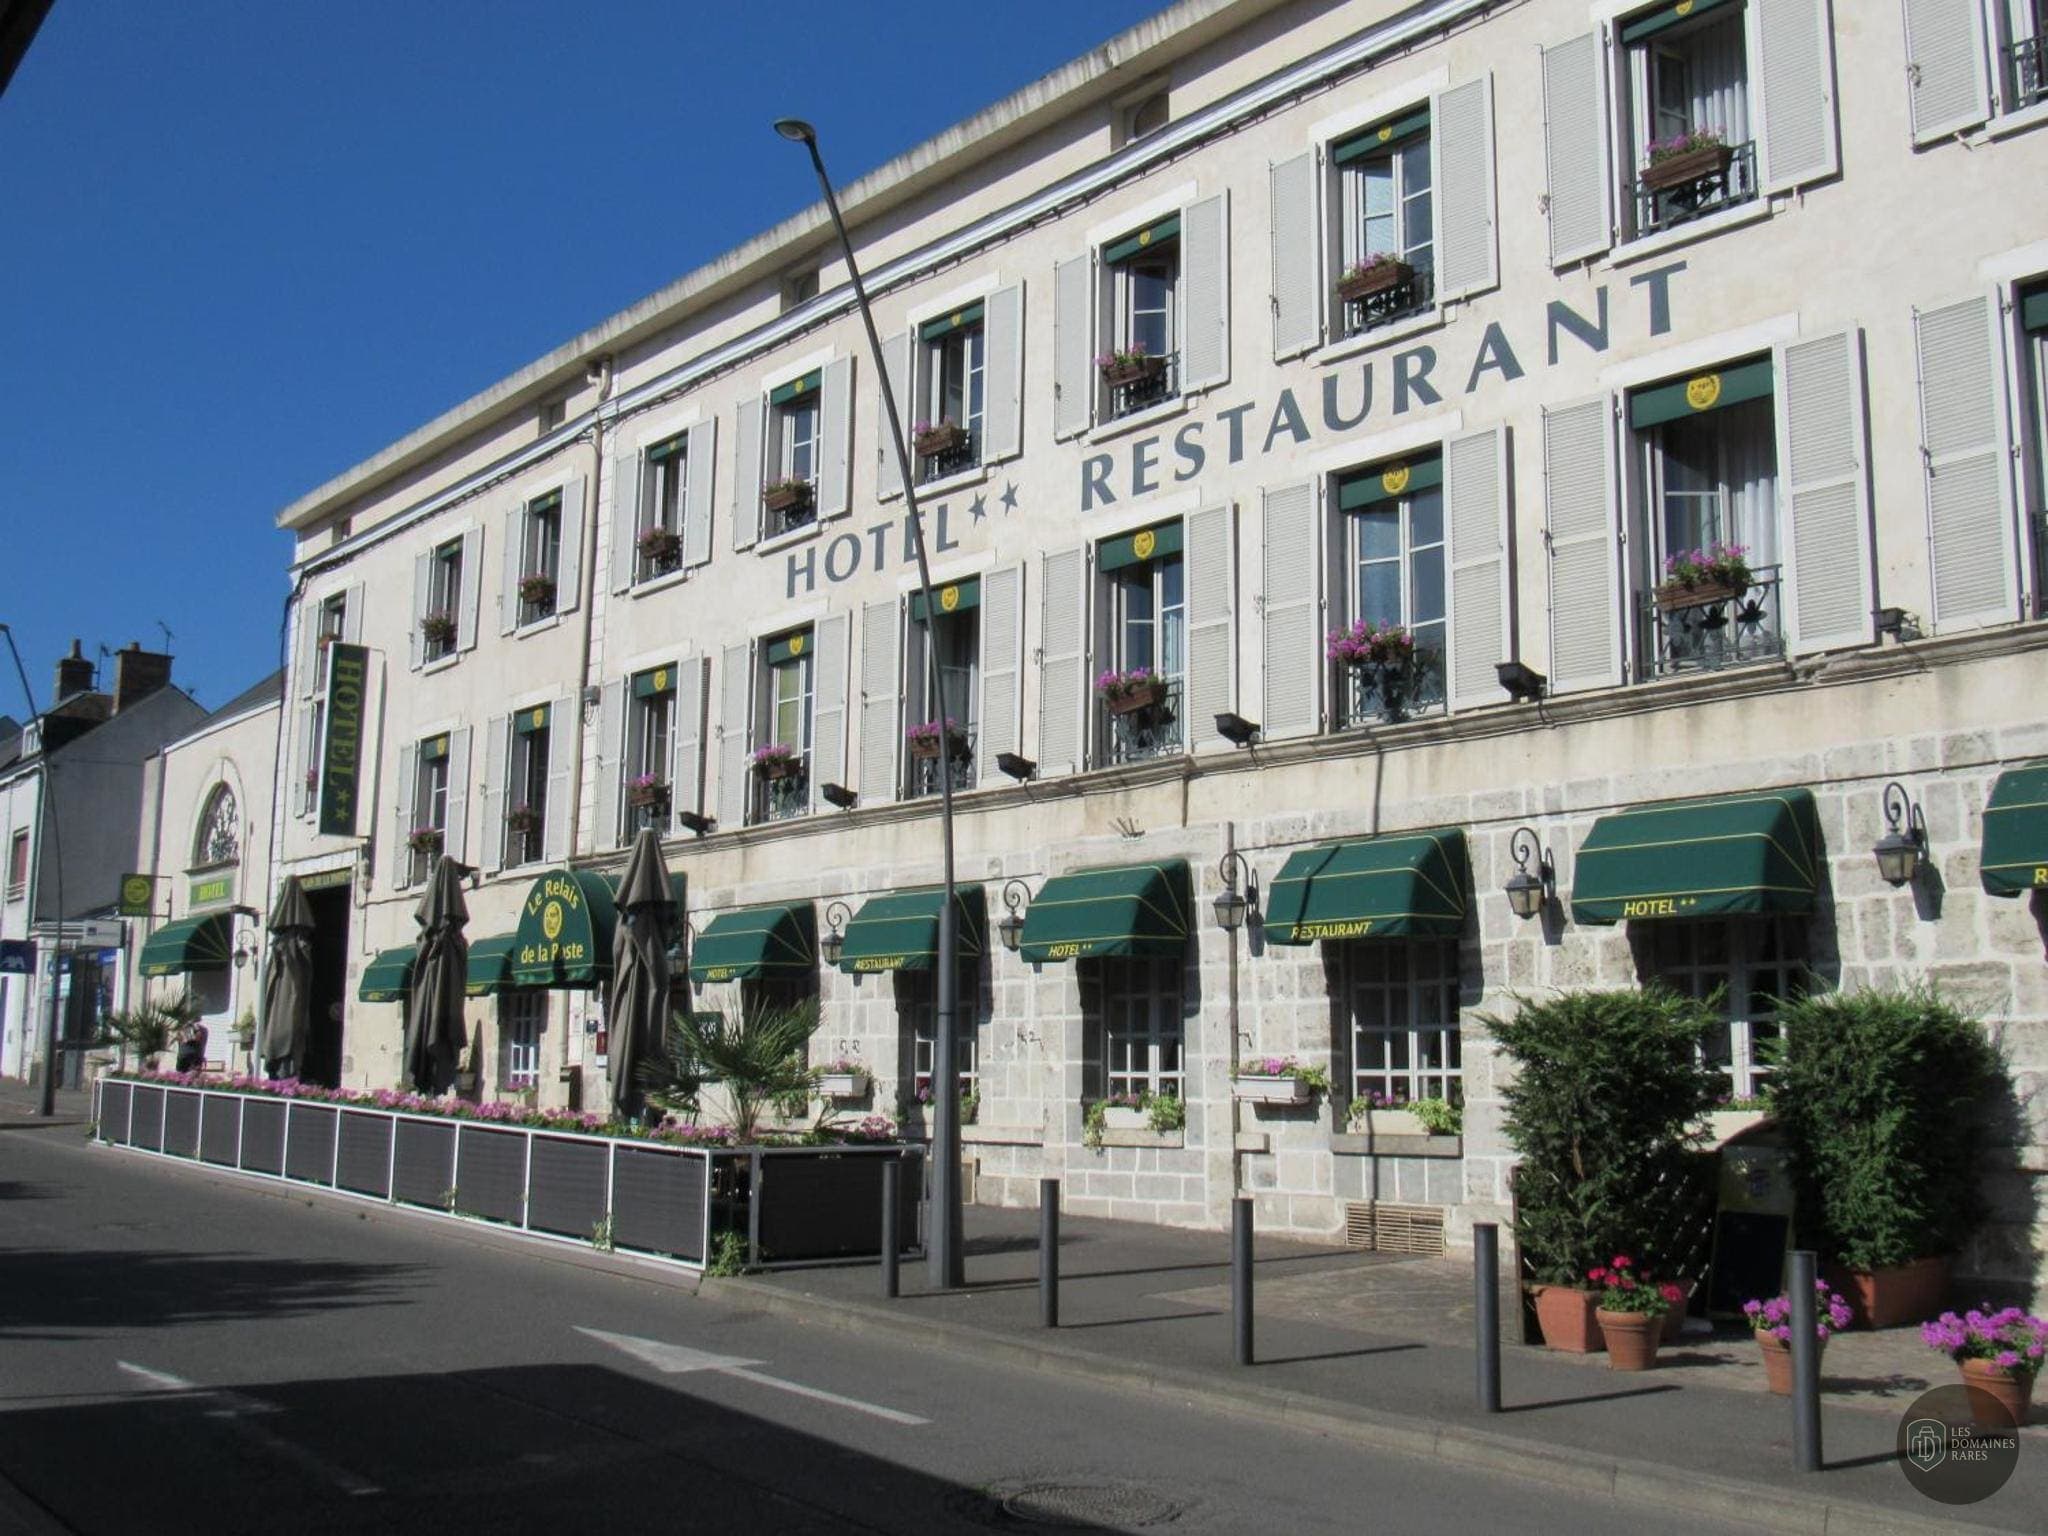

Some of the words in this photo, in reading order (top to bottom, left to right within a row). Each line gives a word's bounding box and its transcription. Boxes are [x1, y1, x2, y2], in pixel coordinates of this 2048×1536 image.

[1080, 260, 1688, 511] RESTAURANT
[329, 660, 362, 787] HOTEL
[527, 892, 543, 916] Le
[545, 876, 580, 910] Relais
[1291, 921, 1373, 940] RESTAURANT
[521, 944, 535, 964] de
[537, 942, 549, 962] la
[854, 957, 905, 970] RESTAURANT
